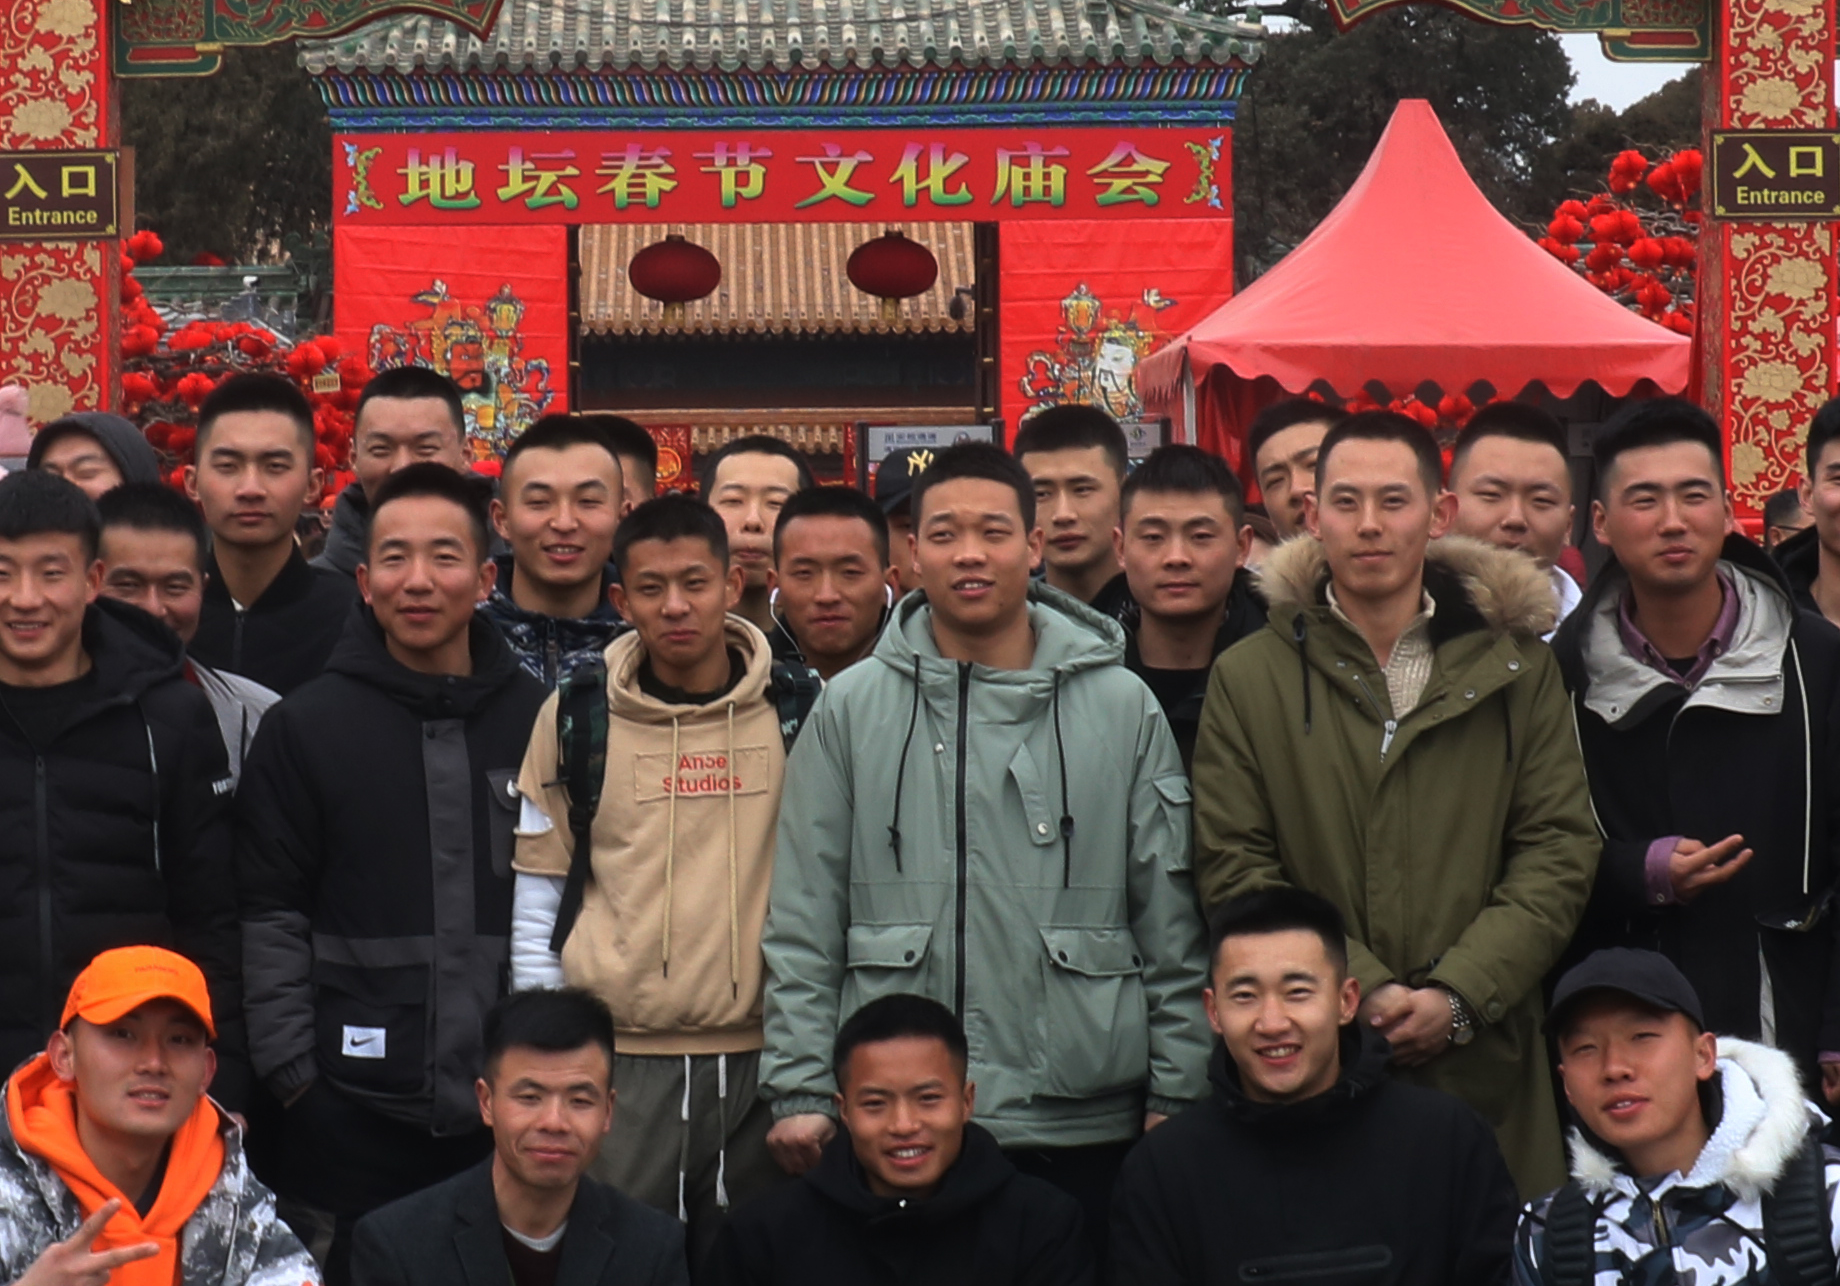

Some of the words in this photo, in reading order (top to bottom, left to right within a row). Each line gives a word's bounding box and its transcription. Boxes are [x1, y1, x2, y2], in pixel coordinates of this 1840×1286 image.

[1732, 142, 1824, 179] 入口
[4, 163, 96, 200] 入口
[397, 141, 1171, 211] 地坛春节文化庙会
[1736, 186, 1825, 205] Entrance
[8, 207, 98, 226] Entrance
[662, 774, 743, 793] Studios
